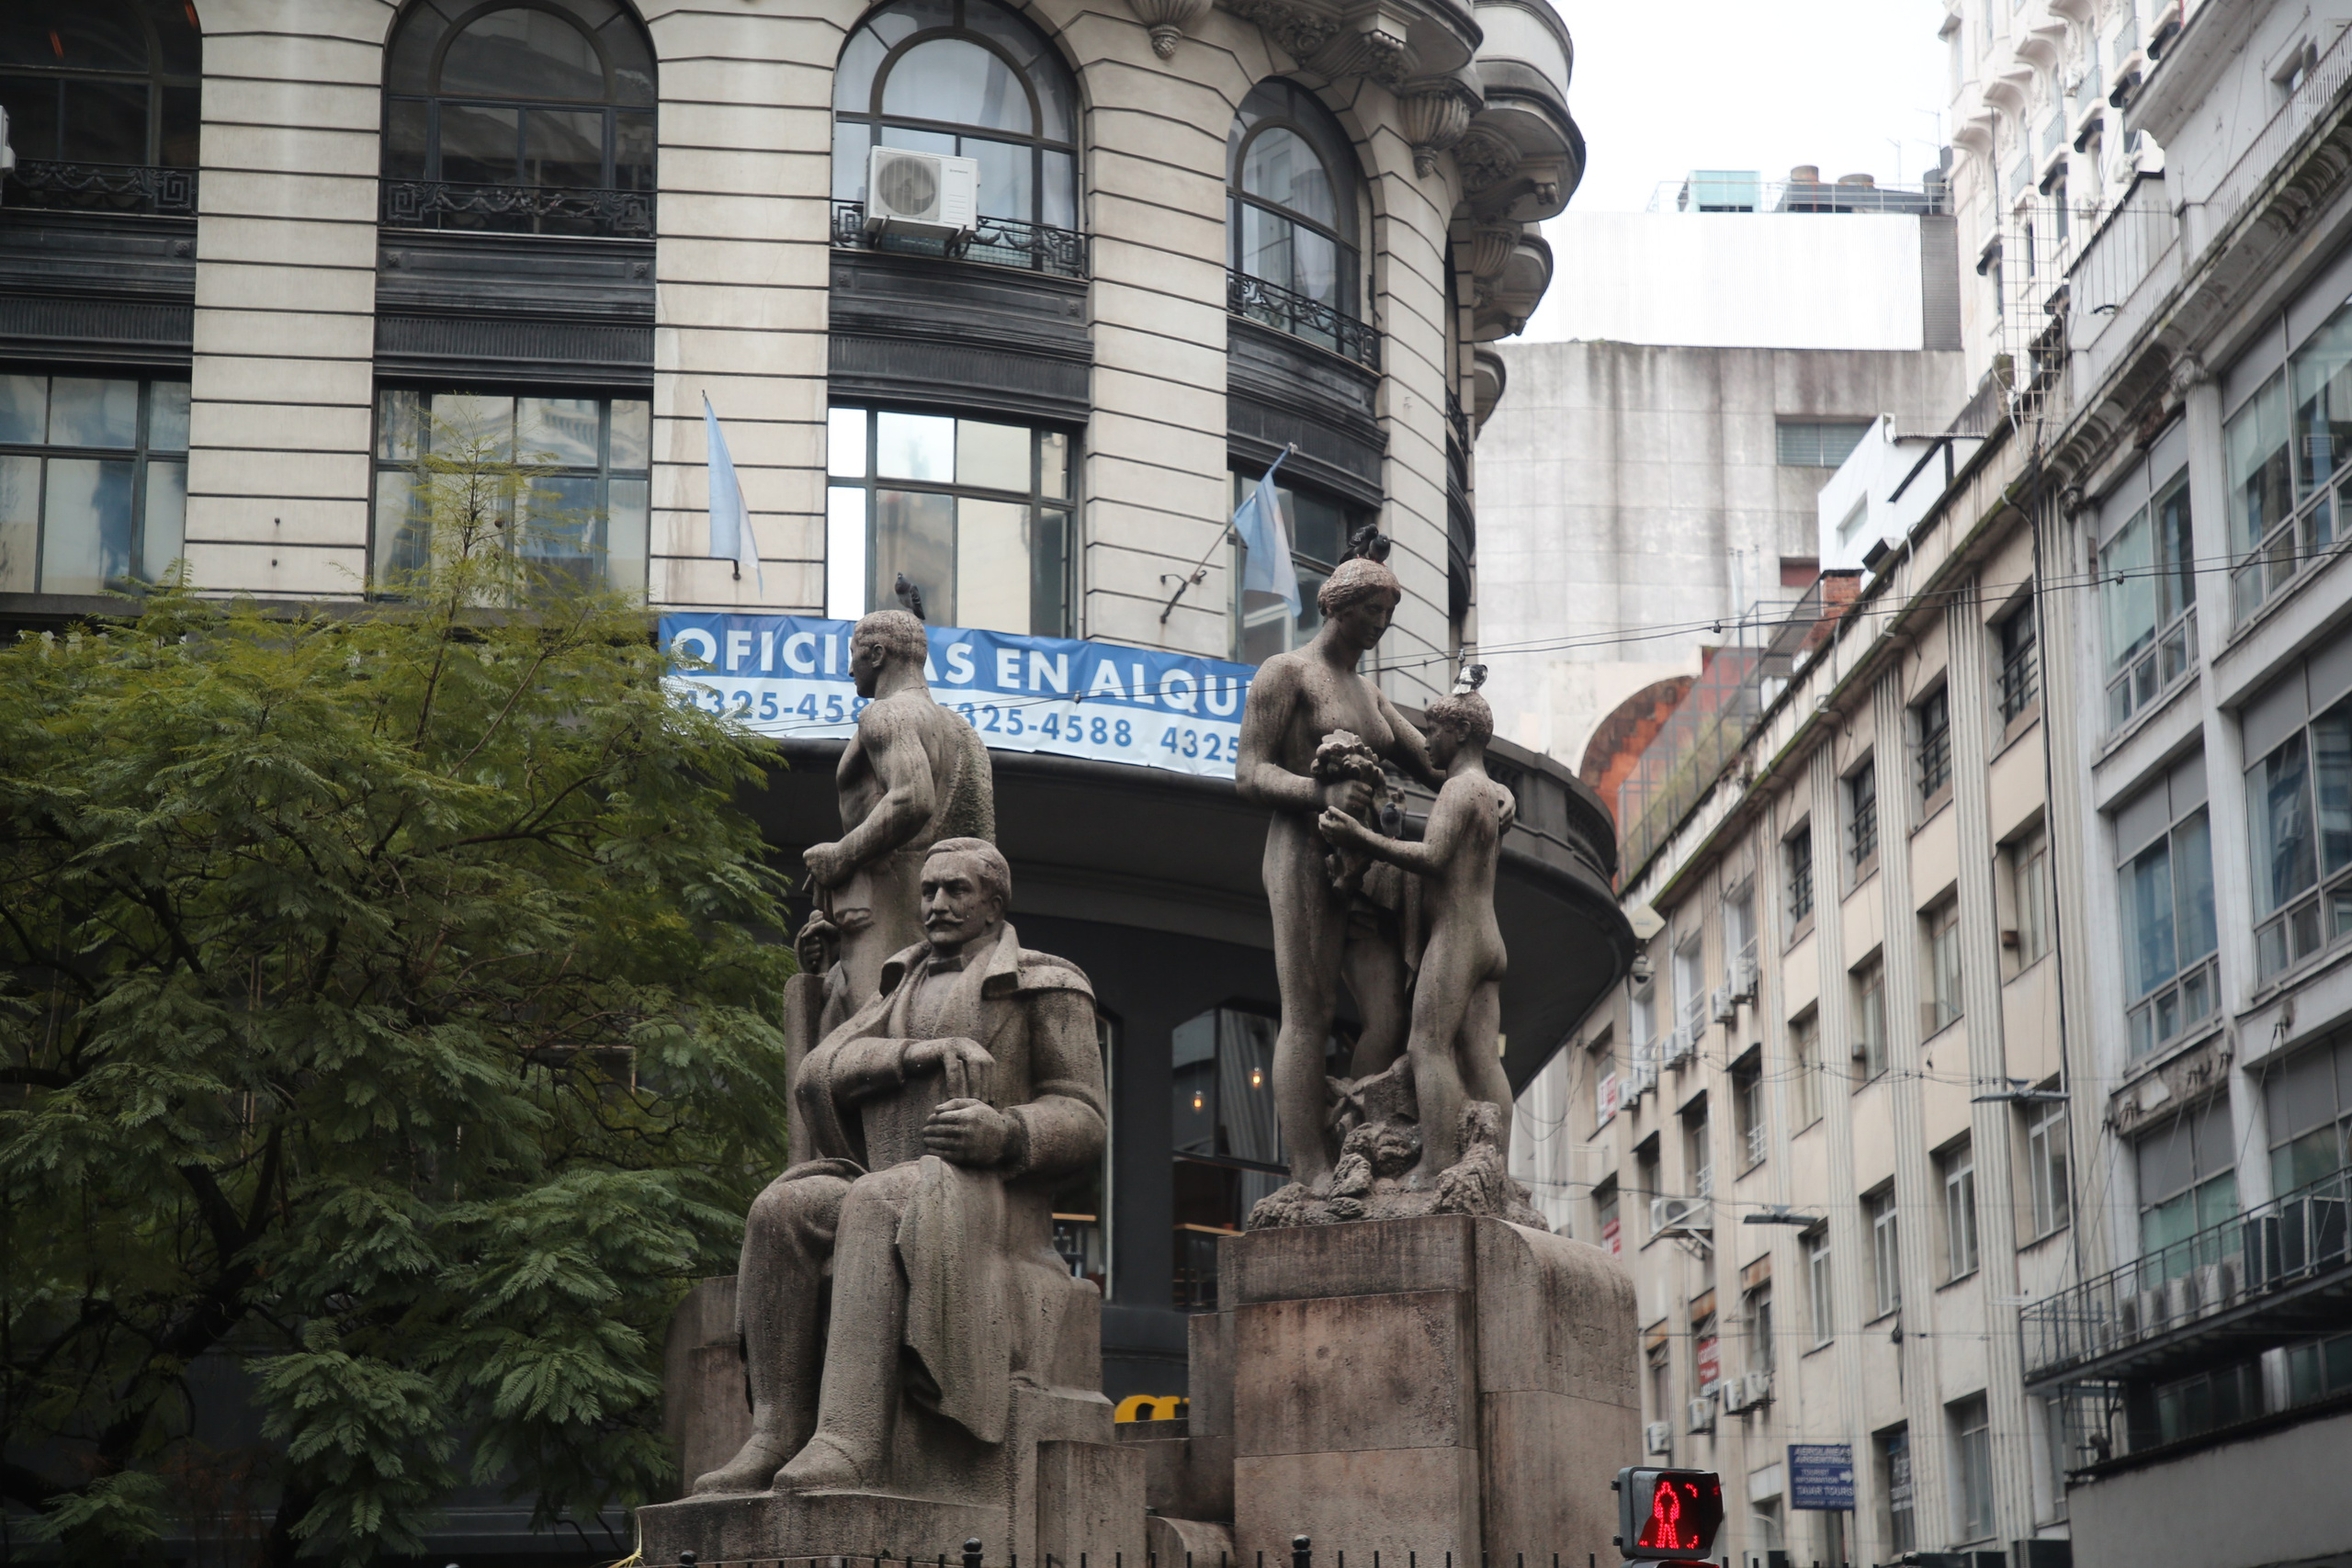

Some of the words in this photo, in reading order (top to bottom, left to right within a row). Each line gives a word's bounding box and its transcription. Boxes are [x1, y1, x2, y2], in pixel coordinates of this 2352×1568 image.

[671, 627, 975, 684] OFICIS
[996, 648, 1069, 694] EN
[1088, 659, 1252, 716] ALQU
[938, 702, 1132, 748] 325-4588
[1825, 1486, 1854, 1497] TOURS
